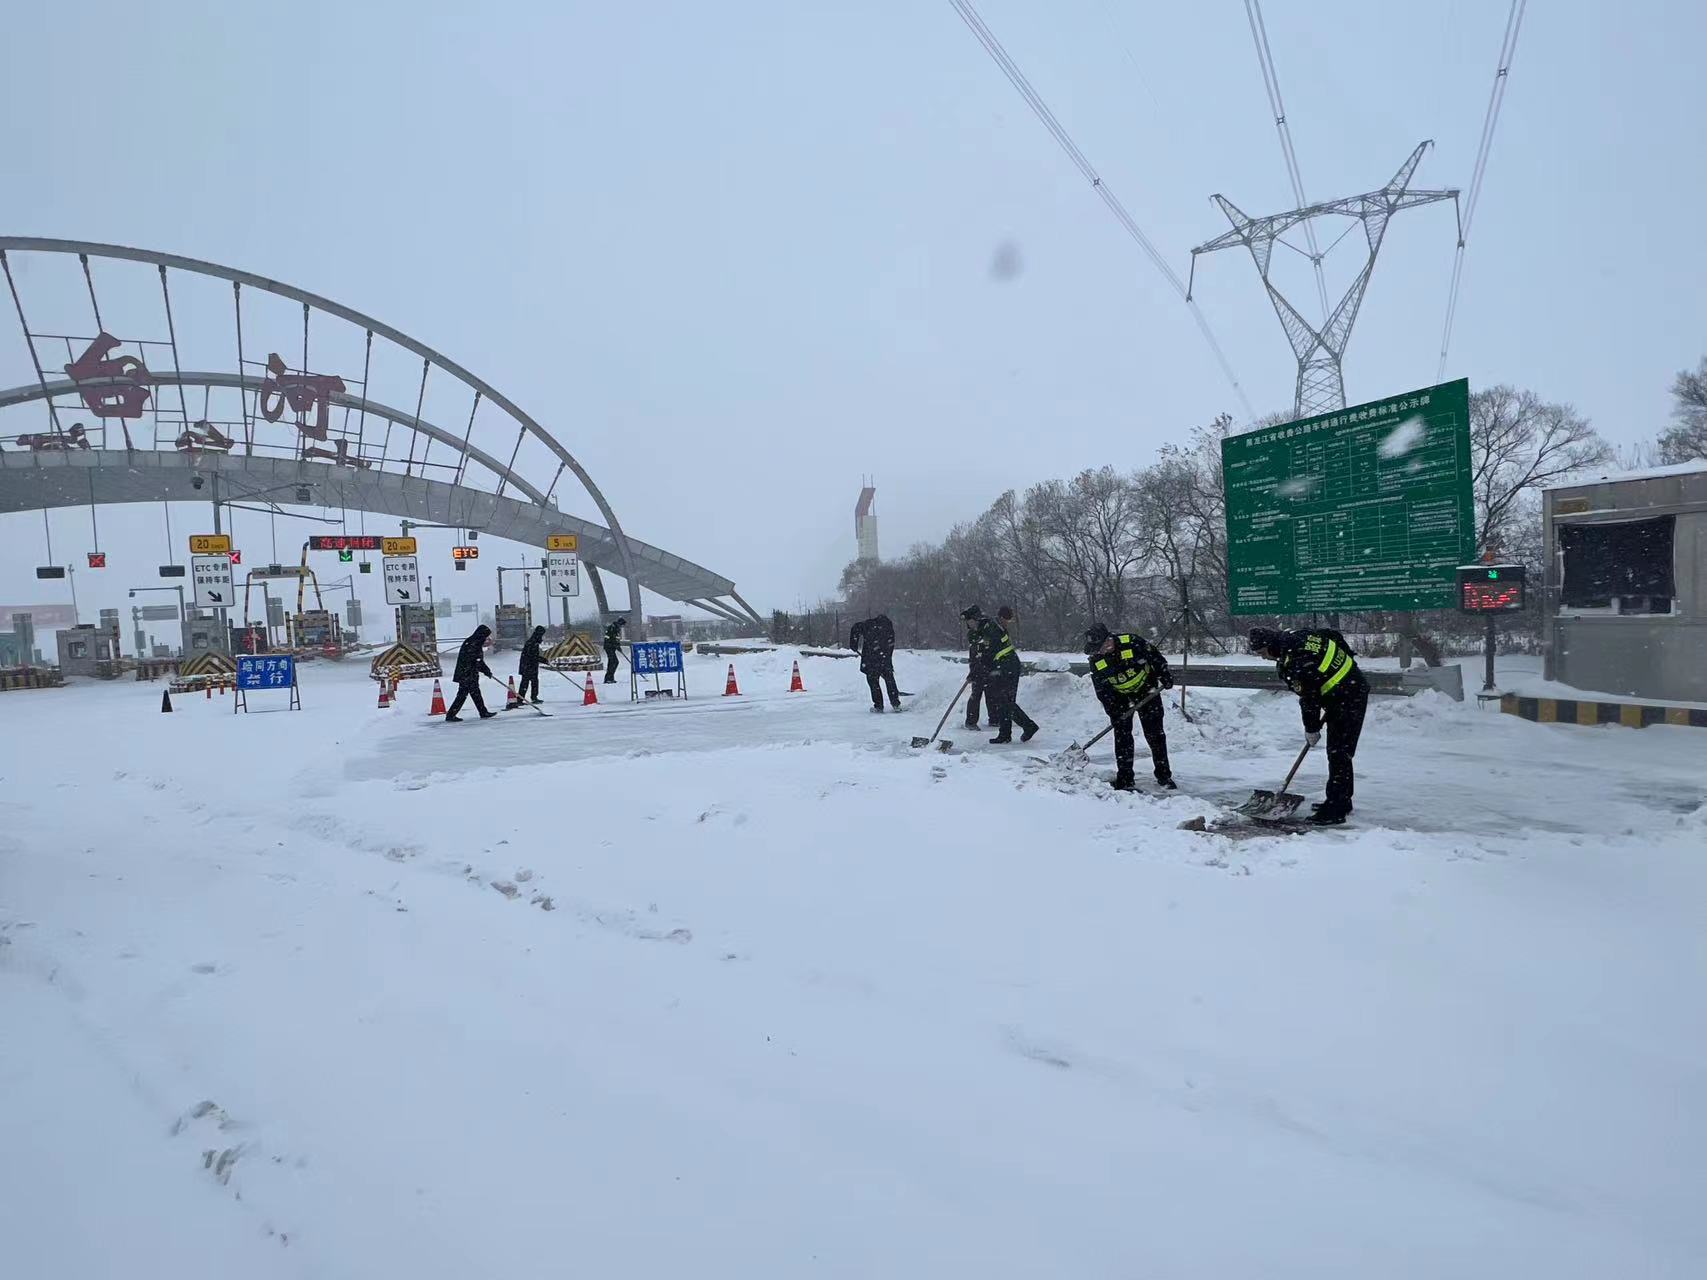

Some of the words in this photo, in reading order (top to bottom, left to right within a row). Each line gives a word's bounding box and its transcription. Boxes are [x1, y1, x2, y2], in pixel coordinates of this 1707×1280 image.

[197, 539, 209, 549] 20
[387, 541, 398, 552] 20
[553, 538, 560, 548] 5
[453, 547, 479, 558] ETC
[195, 564, 211, 572] ETC
[213, 562, 229, 572] 专用
[386, 564, 400, 572] ETC
[401, 562, 416, 571] 专用
[197, 575, 230, 585] 保持车距
[638, 647, 678, 669] 高速封闭
[242, 659, 288, 672] 哈同方向
[247, 670, 284, 685] 禁行
